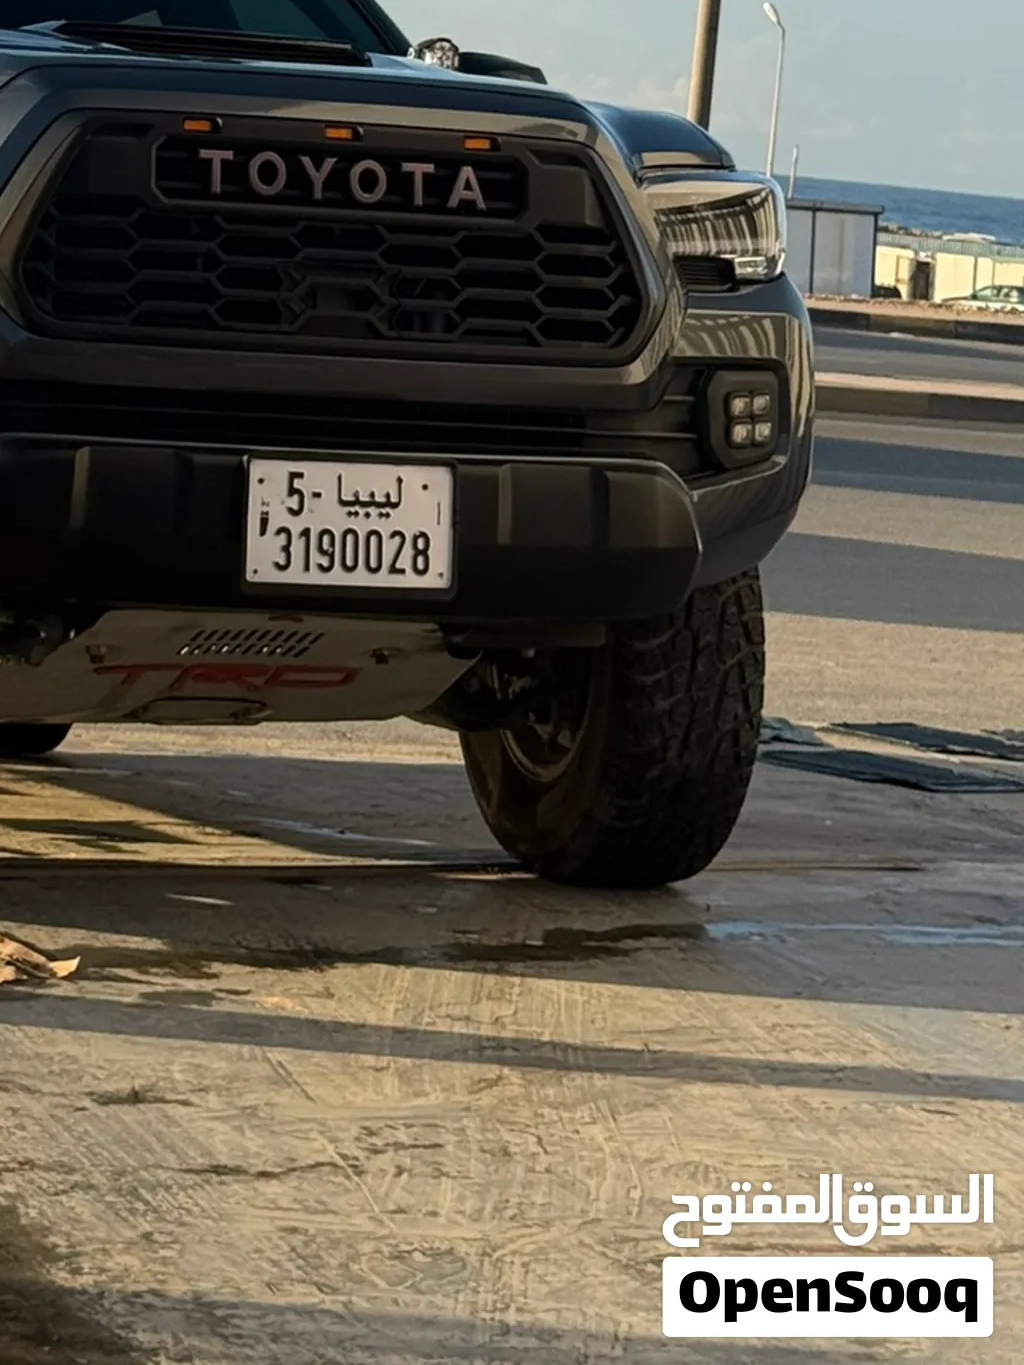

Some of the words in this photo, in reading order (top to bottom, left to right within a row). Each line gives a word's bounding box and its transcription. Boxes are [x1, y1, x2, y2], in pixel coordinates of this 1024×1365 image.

[198, 148, 488, 212] TOYOTA
[336, 473, 404, 520] ليبيا
[272, 526, 431, 577] 3190028
